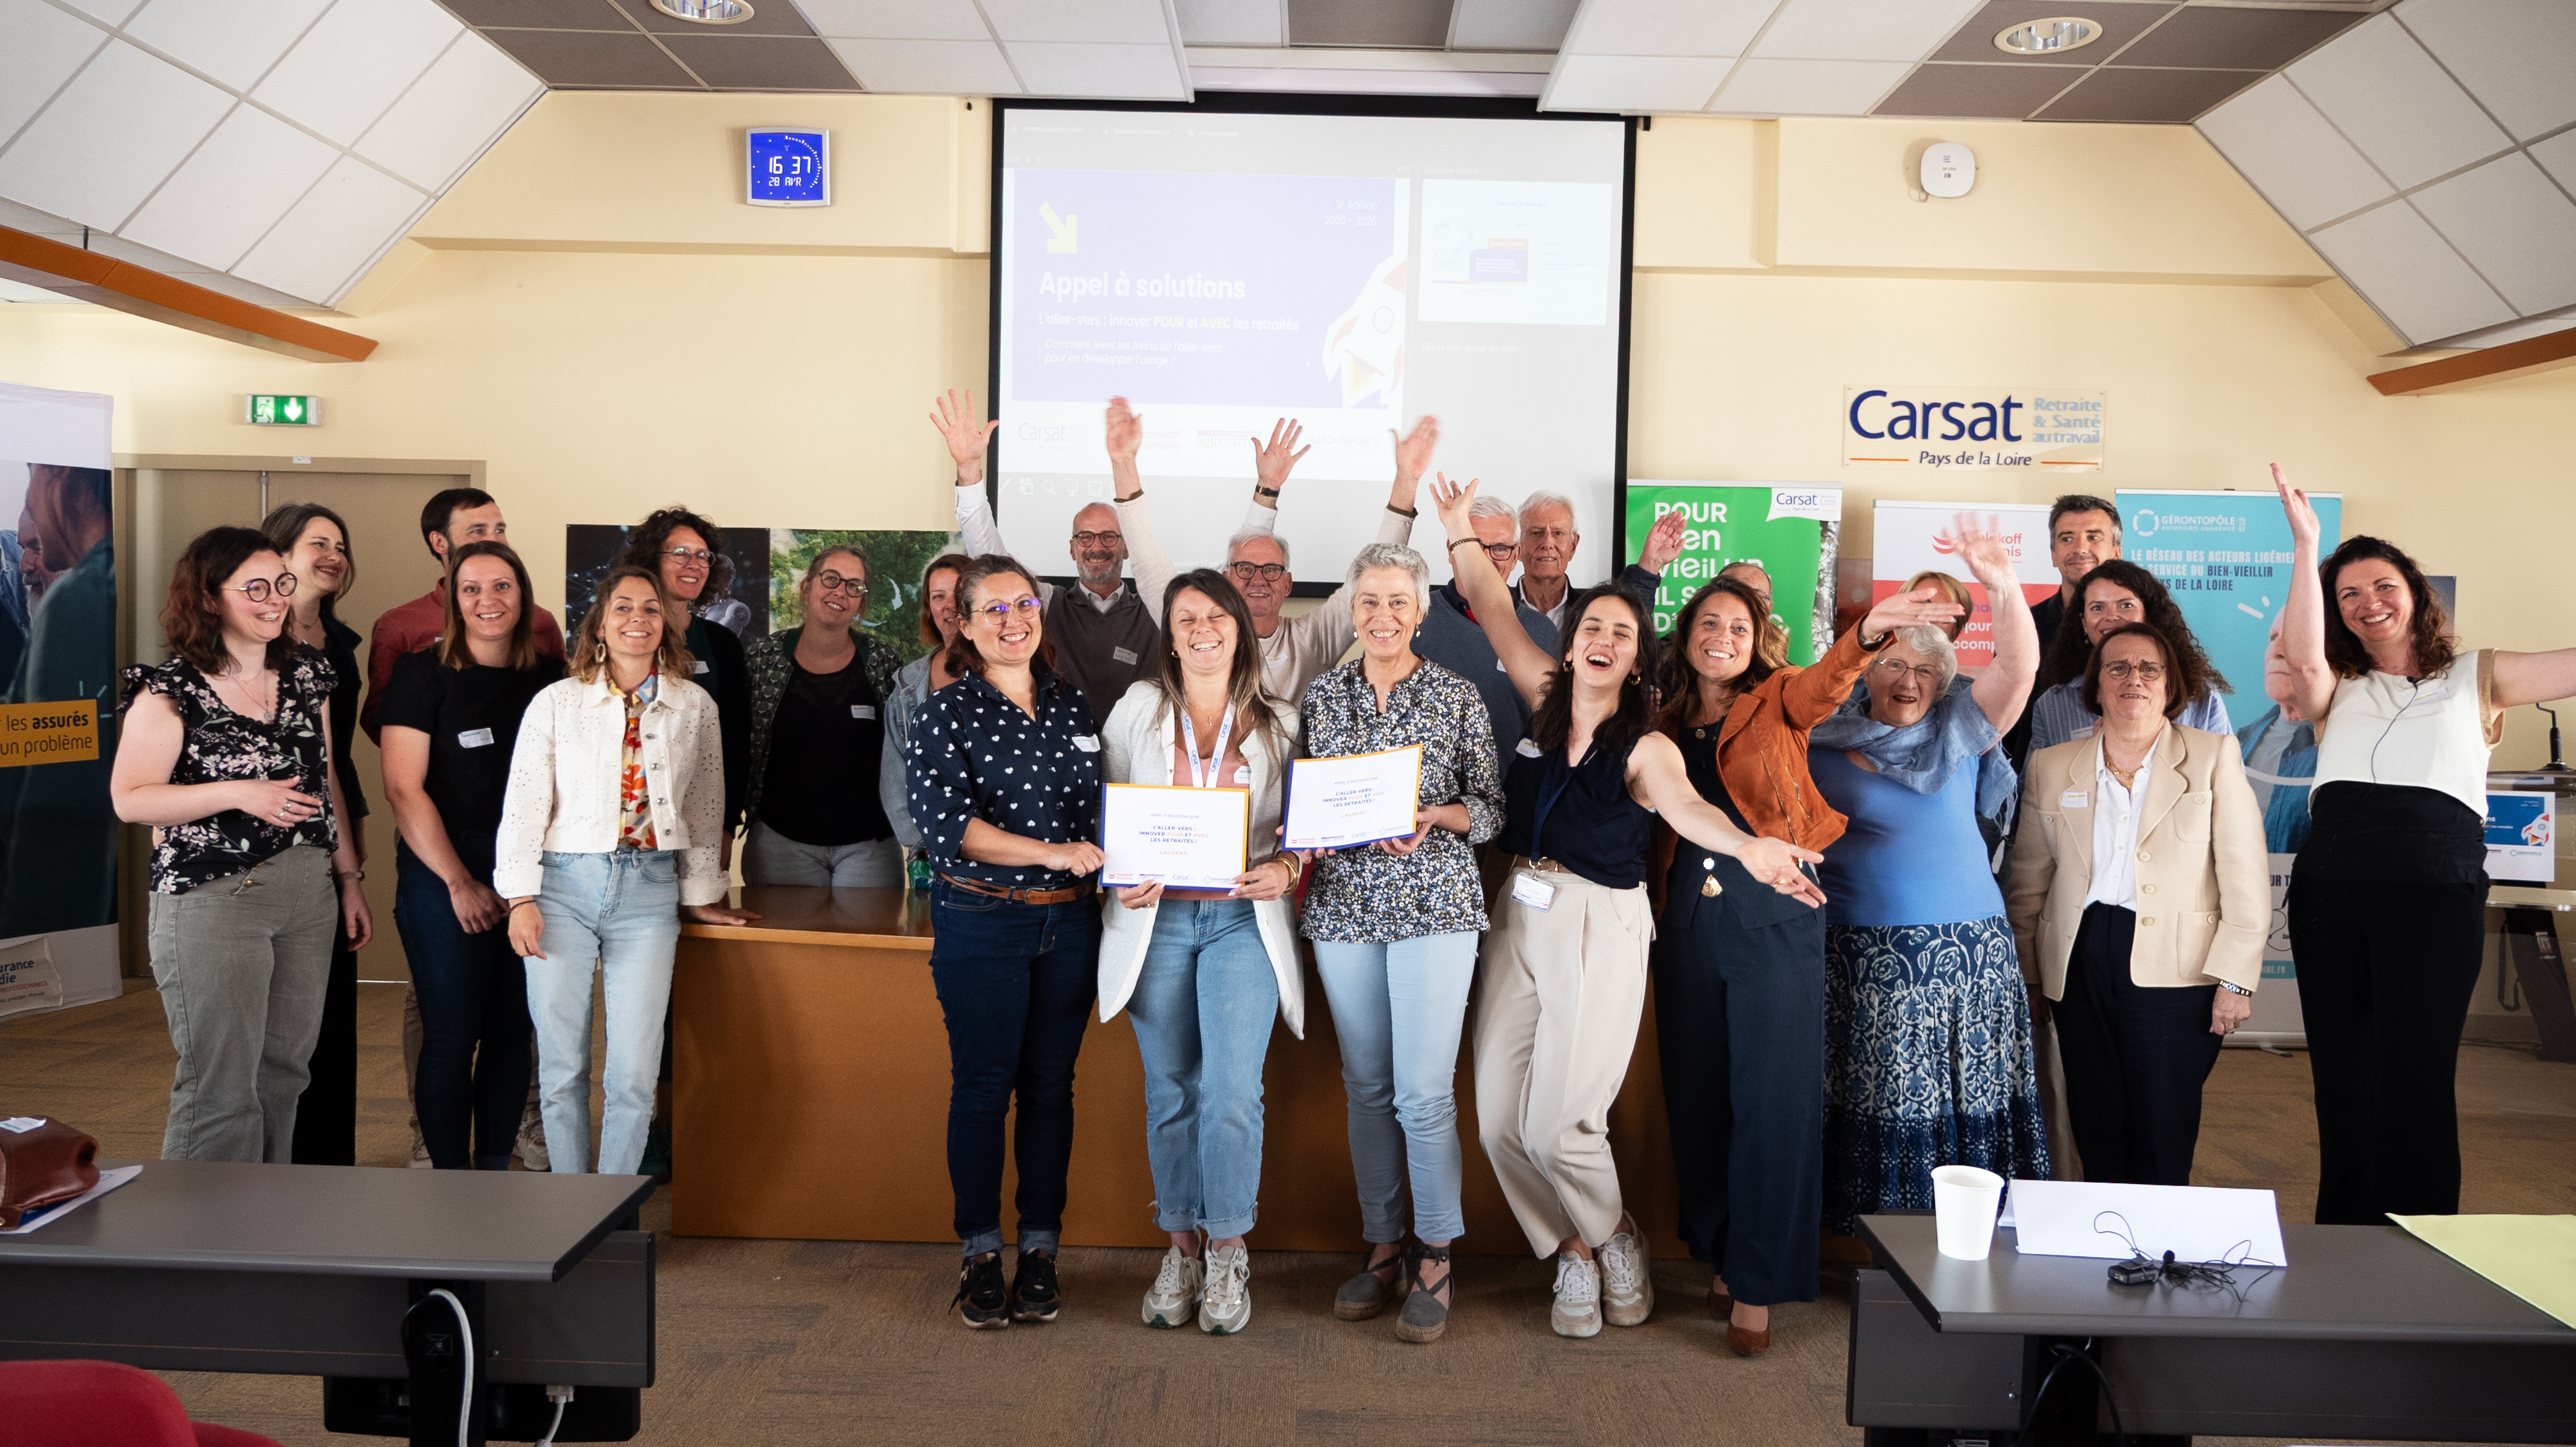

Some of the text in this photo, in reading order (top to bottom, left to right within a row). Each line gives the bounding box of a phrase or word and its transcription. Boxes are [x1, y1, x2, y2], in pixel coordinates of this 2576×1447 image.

[769, 156, 811, 174] 16 37
[768, 176, 802, 187] 28 AVR
[1347, 199, 1377, 210] édition
[1325, 214, 1346, 225] 2025
[1355, 215, 1377, 226] 2026
[1039, 269, 1246, 303] Appel à solutions
[1038, 313, 1101, 326] L'aller-vers
[1108, 313, 1151, 328] innover
[1153, 316, 1185, 328] POUR
[1187, 317, 1198, 328] et
[1200, 317, 1232, 330] AVEC
[1233, 317, 1250, 330] les
[1251, 318, 1300, 331] retraités
[1045, 339, 1222, 353] Comment lever les freins de l'aller-vers
[1044, 353, 1176, 369] pour en développer l'usage ?
[2033, 398, 2101, 412] Retraite
[1849, 389, 2023, 442] Carsat
[2033, 414, 2101, 428] & Santé
[1017, 422, 1067, 442] Carsat
[1311, 434, 1370, 446] GÉRONTOPÔLE
[1919, 451, 2032, 467] Pays de la Loire
[1776, 492, 1818, 505] Carsat
[1655, 502, 1727, 523] POUR
[2161, 514, 2235, 525] GÉRONTOPÔLE
[2131, 549, 2142, 562] LE
[2146, 547, 2183, 563] RÉSEAU
[2186, 550, 2205, 563] DES
[2208, 550, 2251, 564] ACTEURS
[2190, 565, 2204, 577] DU
[2207, 565, 2273, 578] BIEN-VIEILLIR
[2175, 579, 2187, 590] DE
[2190, 579, 2203, 591] LA
[2207, 580, 2233, 591] LOIRE
[7, 710, 89, 731] les assurés
[0, 734, 92, 757] un problème
[1336, 788, 1371, 796] L'ALLER-VERS
[1344, 798, 1372, 806] RETRAITÉS
